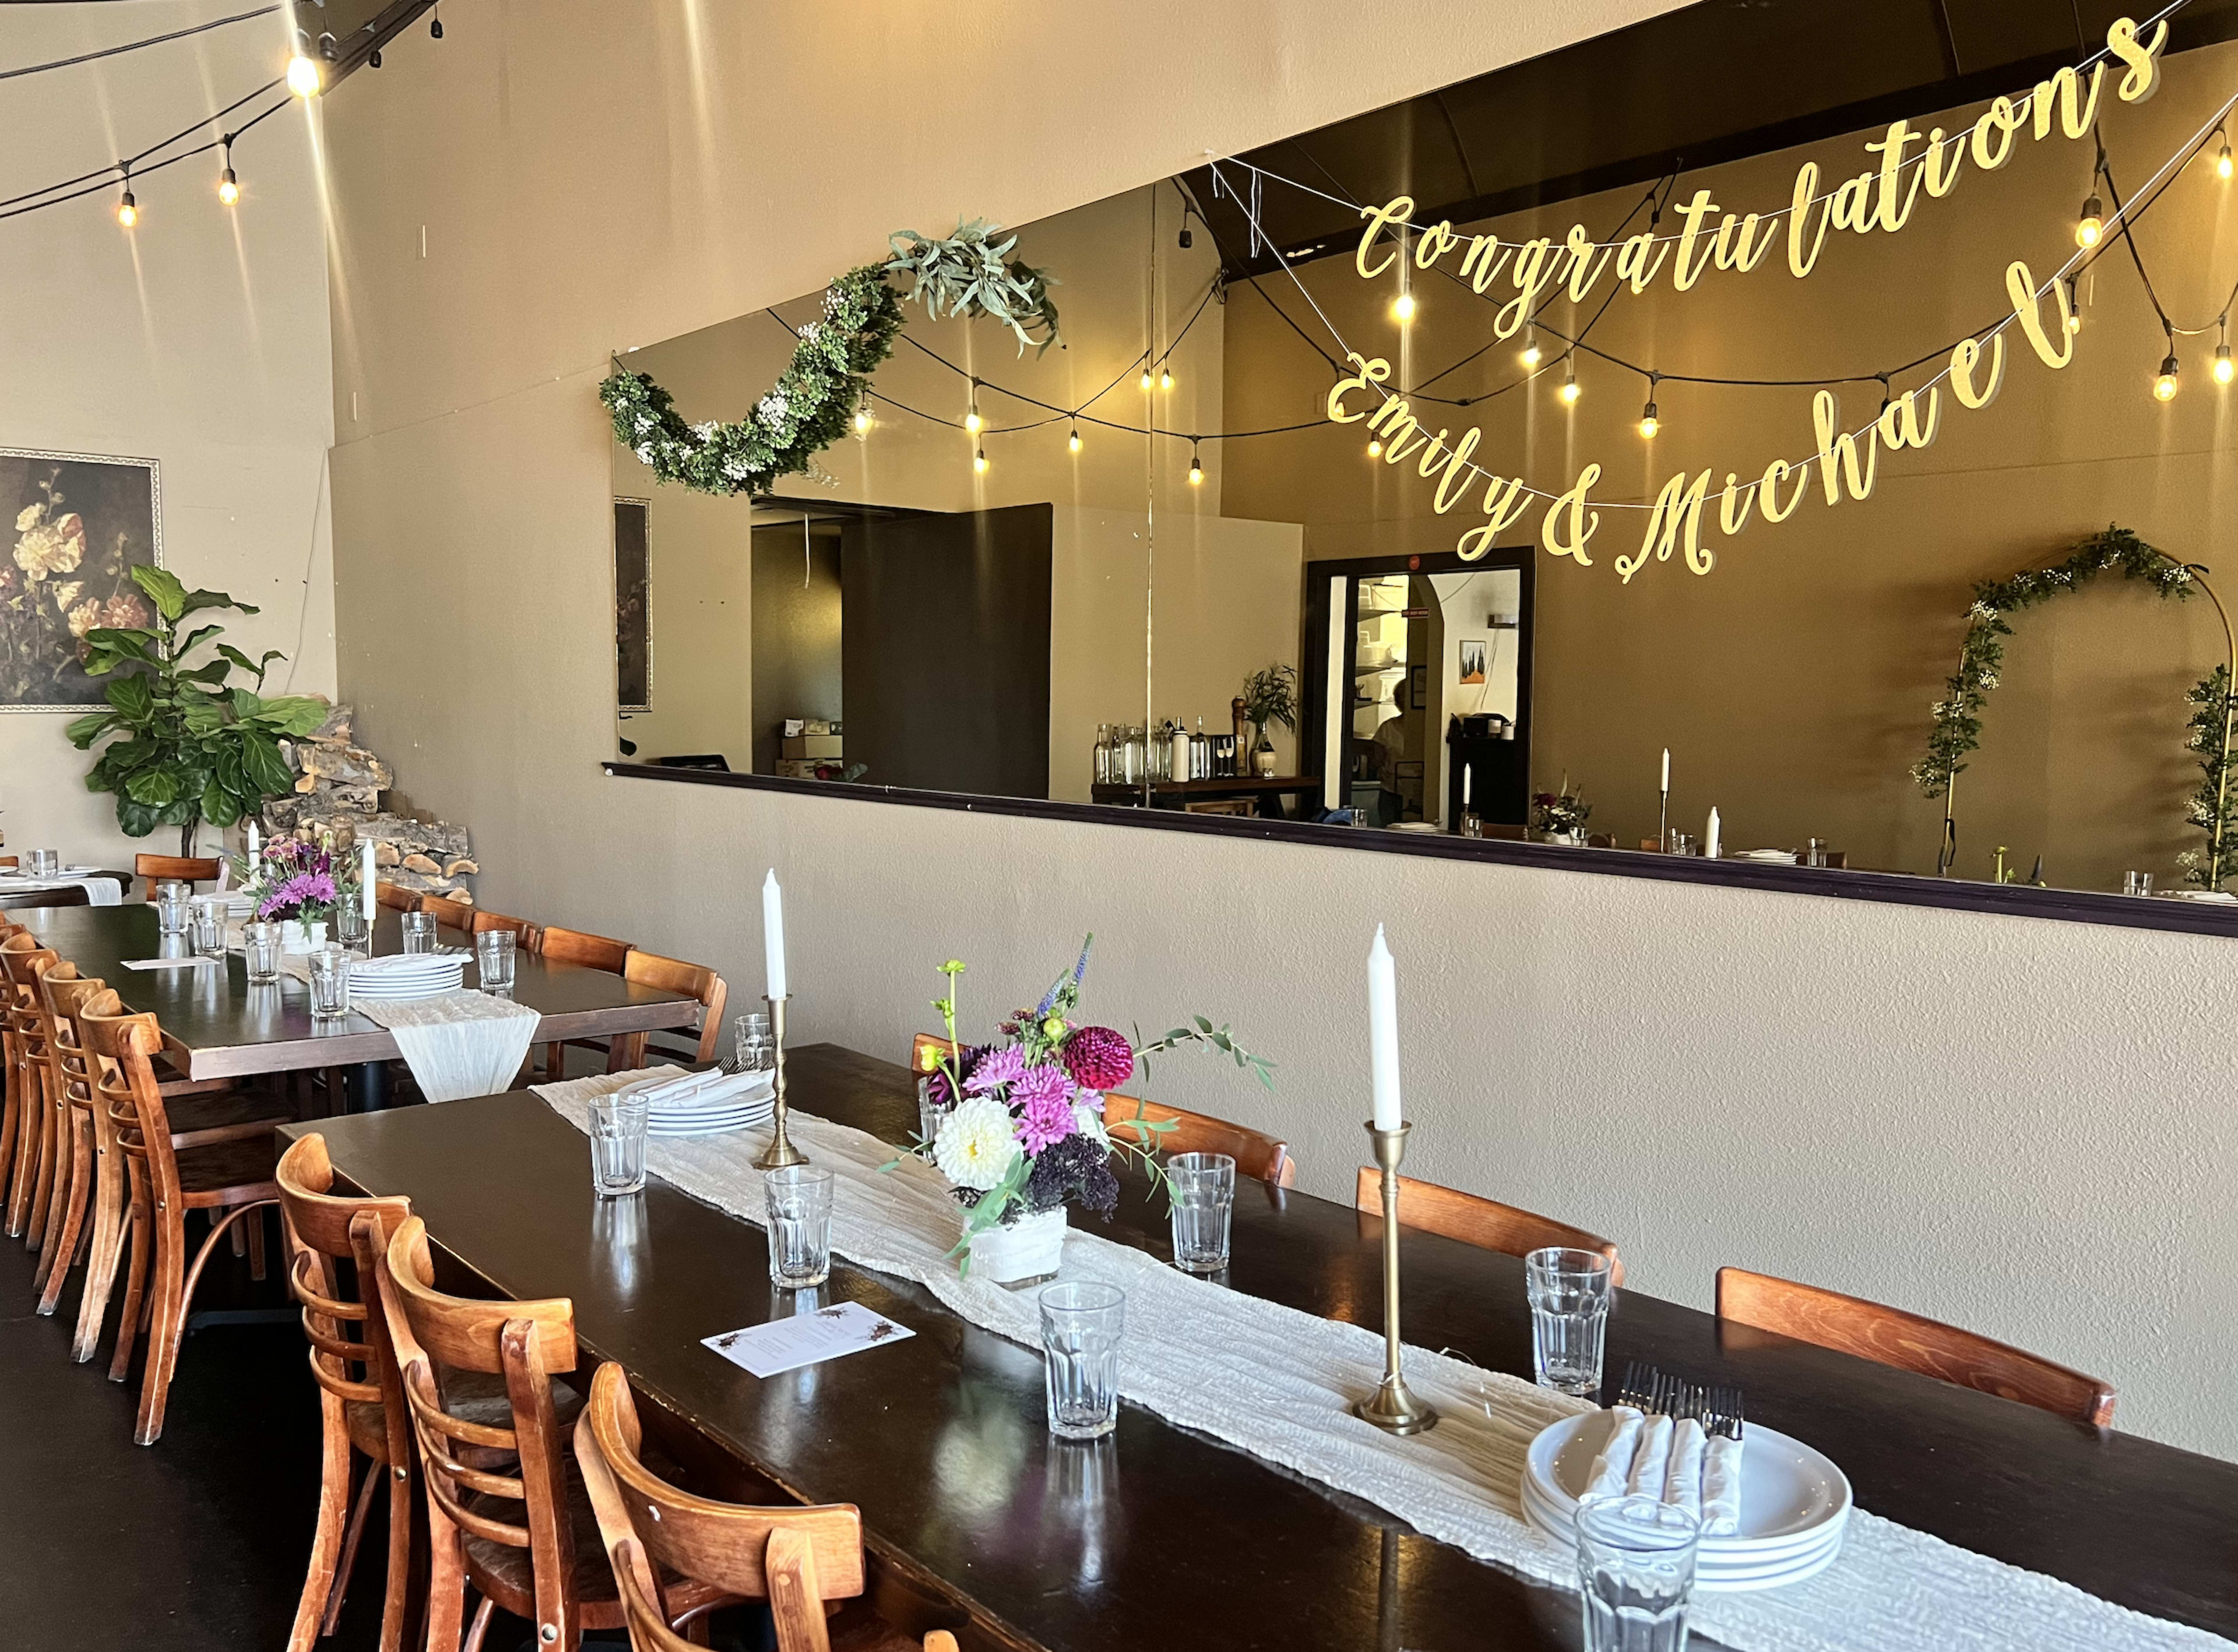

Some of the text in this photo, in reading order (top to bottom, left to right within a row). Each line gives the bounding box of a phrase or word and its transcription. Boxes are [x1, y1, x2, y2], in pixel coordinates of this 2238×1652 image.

[1355, 16, 2168, 340] Congratulations
[1327, 260, 2076, 585] Emily & Michael
